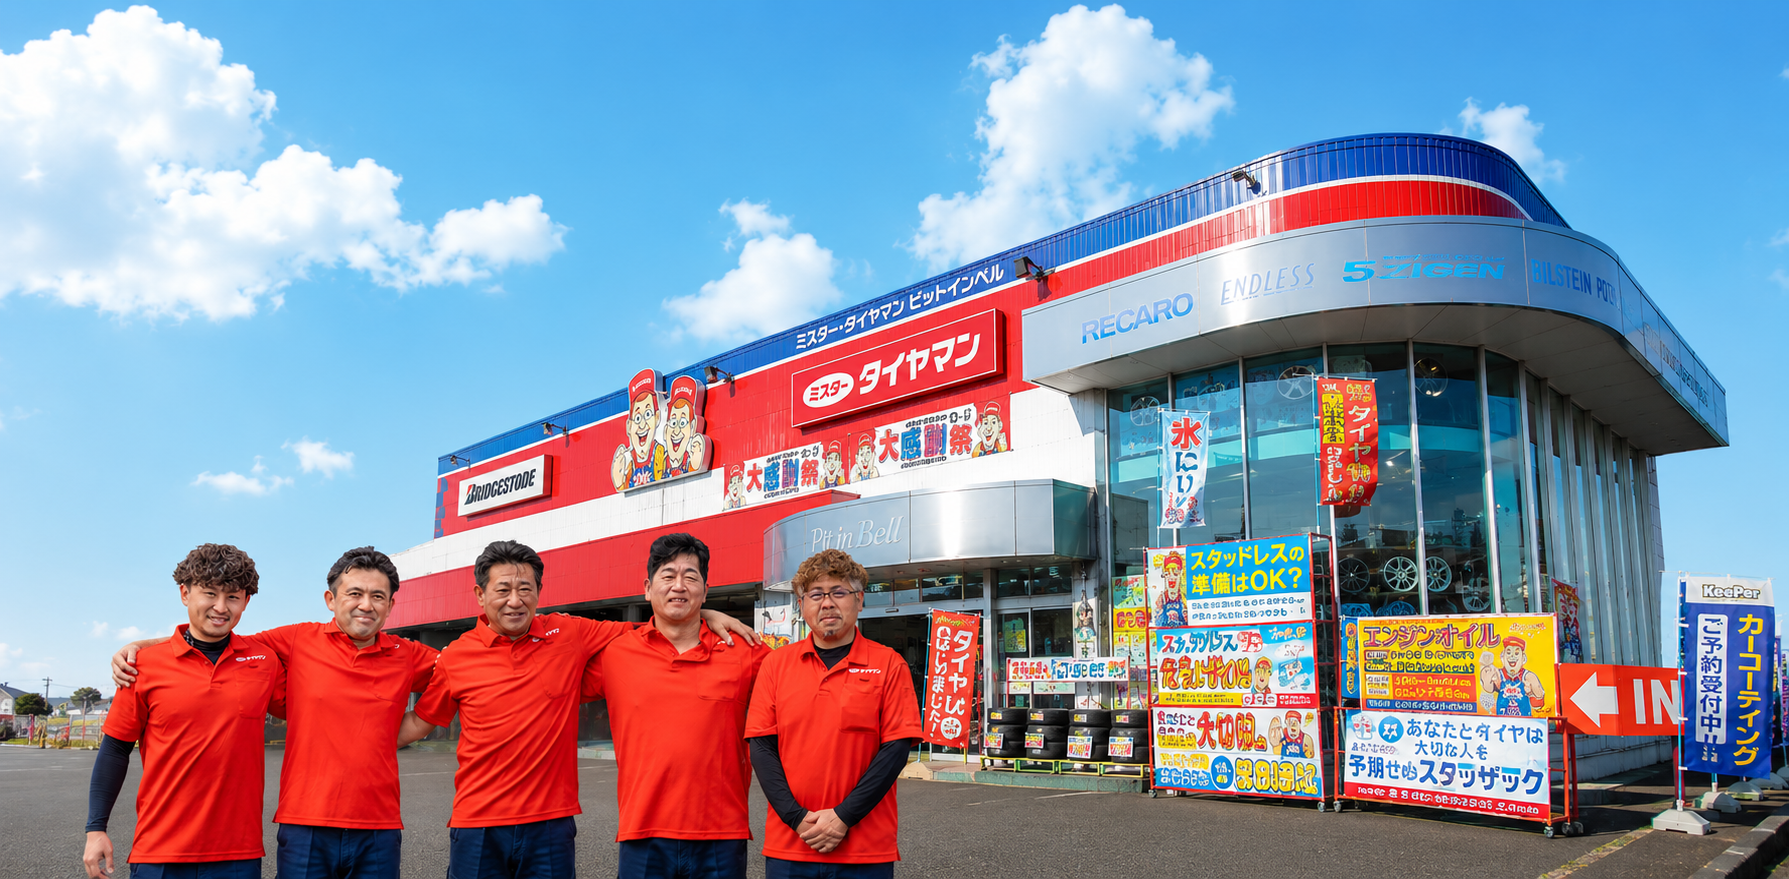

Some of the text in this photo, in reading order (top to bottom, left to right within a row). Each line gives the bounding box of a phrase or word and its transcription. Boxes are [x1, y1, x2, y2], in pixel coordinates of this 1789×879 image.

[1220, 262, 1315, 306] ENDLESS
[1531, 258, 1592, 296] BILSTEIN
[1081, 292, 1194, 345] RECARO
[808, 332, 981, 402] ミスター タイヤマン
[855, 515, 905, 548] Bell
[1191, 543, 1305, 571] スタッドレスの
[1702, 583, 1760, 600] KeePer
[1363, 623, 1501, 650] エンジンオイル
[1633, 678, 1679, 725] IN
[1732, 613, 1764, 766] カーコーティング
